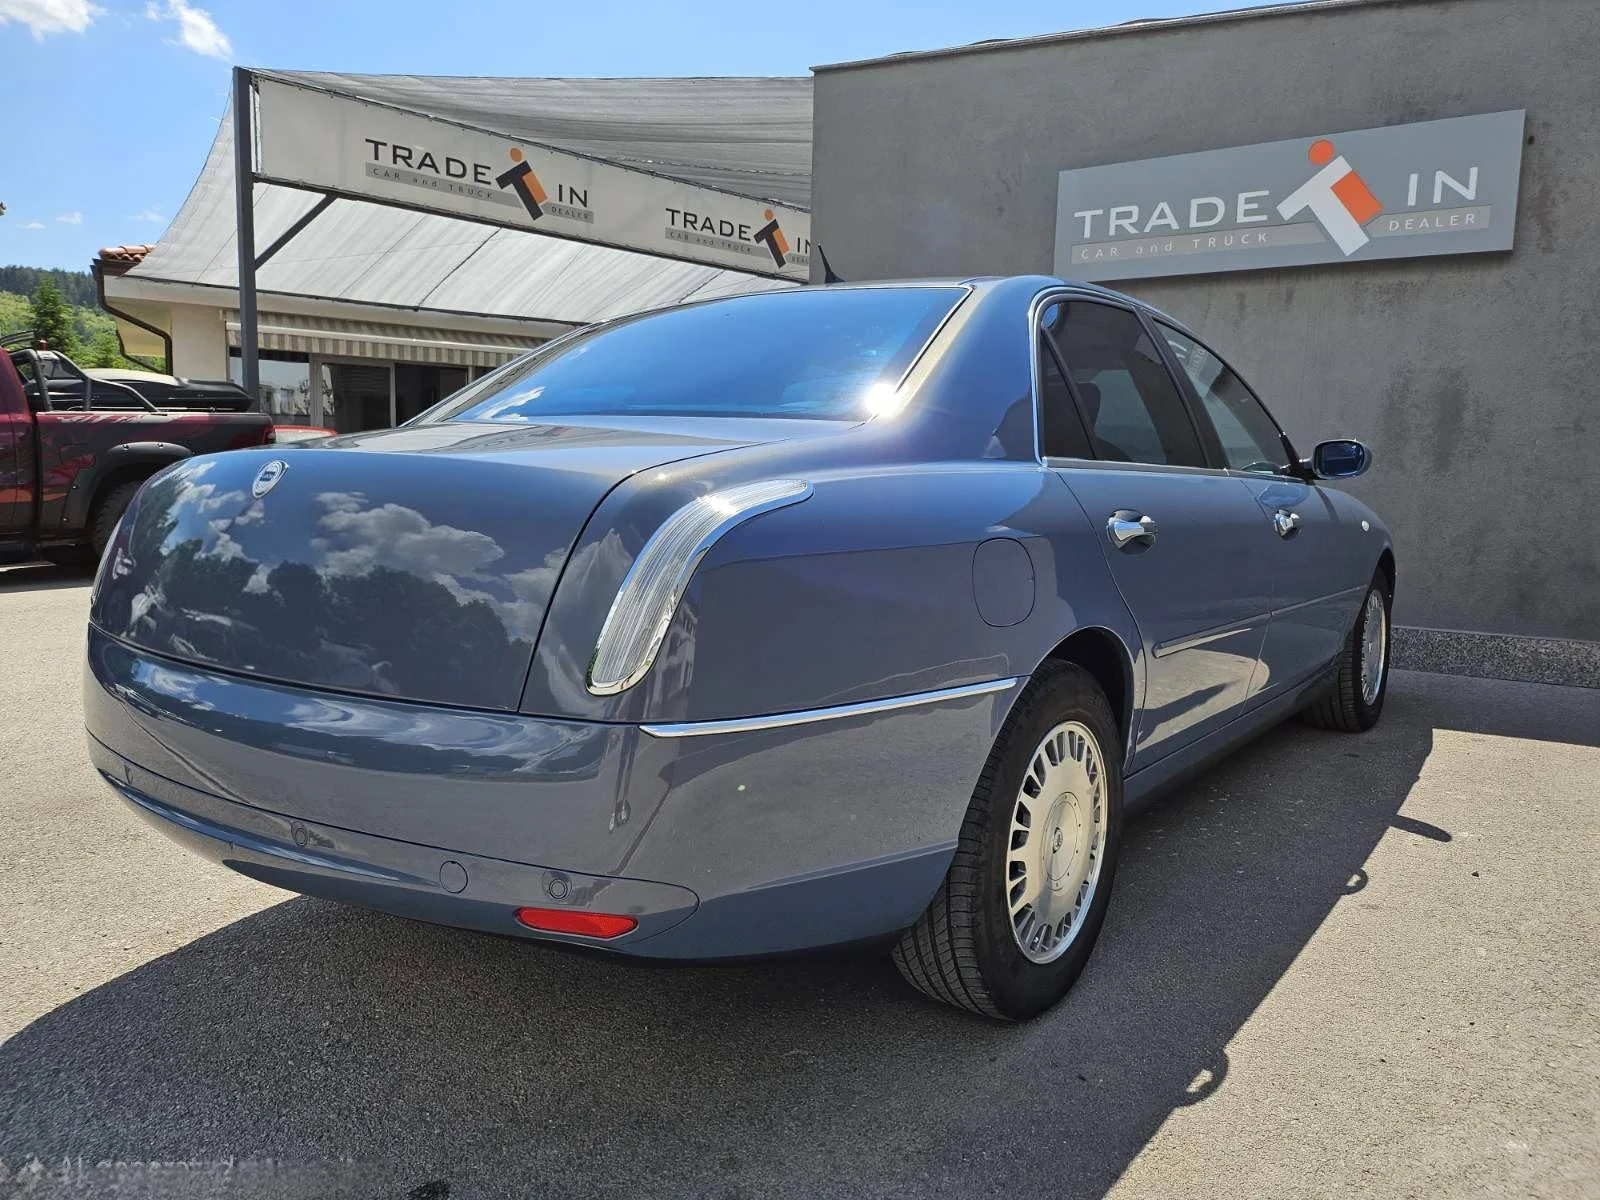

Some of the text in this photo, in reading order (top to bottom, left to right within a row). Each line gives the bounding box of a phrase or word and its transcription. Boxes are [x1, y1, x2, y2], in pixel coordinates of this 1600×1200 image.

[365, 138, 492, 186] TRADE
[558, 183, 588, 208] IN
[373, 167, 590, 220] CAR and TRUCK DEALER
[665, 208, 751, 242] TRADE
[1073, 190, 1270, 239] TRADE
[1407, 166, 1479, 207] IN
[1080, 213, 1476, 260] CAR and TRUCK DEALER
